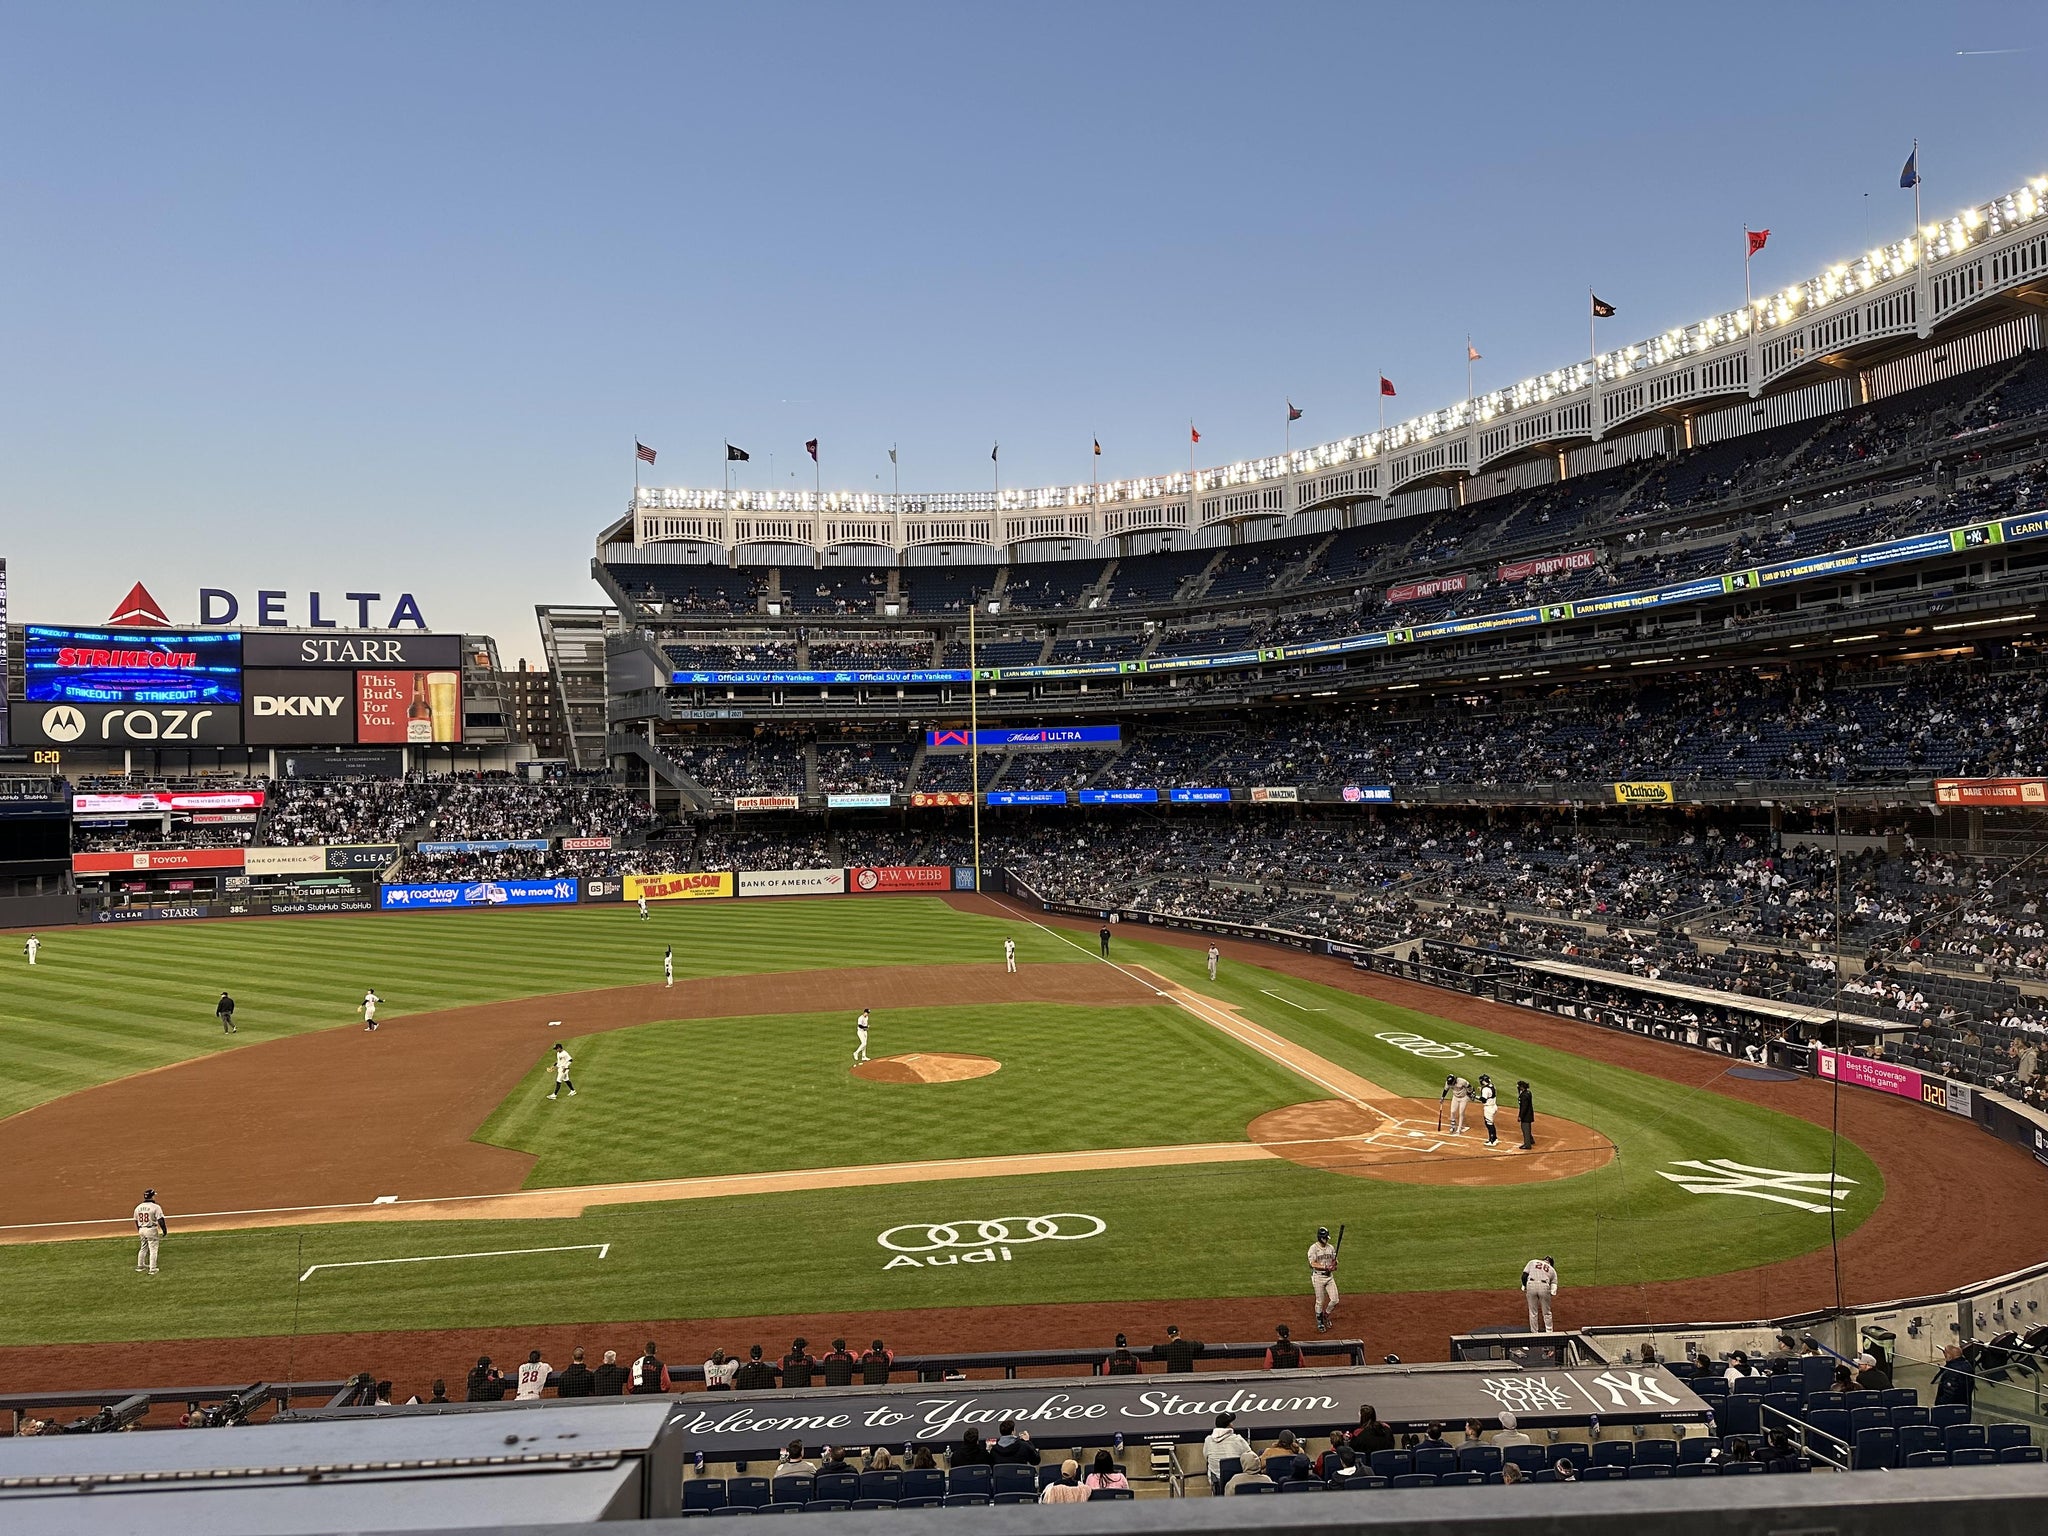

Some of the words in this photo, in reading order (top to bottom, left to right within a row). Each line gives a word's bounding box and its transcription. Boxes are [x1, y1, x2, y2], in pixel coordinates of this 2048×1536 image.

[2010, 522, 2042, 536] LEARN
[1536, 559, 1564, 574] PARTY
[1564, 554, 1590, 568] DECK
[1417, 582, 1442, 596] PARTY
[1442, 577, 1463, 592] DECK
[200, 588, 427, 629] DELTA
[1577, 605, 1594, 614] EARN
[1594, 603, 1612, 612] FOUR
[1614, 600, 1630, 609] FREE
[28, 628, 69, 638] STRIKEOUT!
[1416, 630, 1432, 638] LEARN
[302, 639, 406, 663] STARR
[56, 647, 196, 668] STRIKEOUT!
[362, 675, 396, 686] This
[718, 674, 744, 682] Official
[746, 674, 761, 682] SUV
[762, 674, 770, 682] of
[771, 674, 784, 682] the
[785, 674, 814, 682] Yankees
[859, 673, 885, 681] Official
[886, 673, 901, 681] SUV
[902, 672, 911, 680] of
[925, 672, 952, 680] Yankees
[66, 686, 122, 700] STRIKEOUT!
[135, 690, 196, 700] STRIKEOUT!
[363, 688, 403, 700] Bud's
[254, 696, 344, 716] DKNY
[363, 701, 388, 712] For
[102, 710, 212, 740] razr
[362, 714, 395, 726] You.
[1006, 733, 1040, 742] Michelob
[1048, 732, 1081, 740] ULTRA
[34, 751, 59, 764] 0:20
[1619, 784, 1667, 799] Nathan's
[1962, 788, 1982, 796] DARE
[1983, 788, 1991, 796] TO
[1992, 788, 2017, 796] LISTEN
[2025, 787, 2040, 796] JBL
[737, 799, 757, 807] Parts
[759, 797, 795, 807] Authority
[223, 814, 255, 822] TERRACE
[564, 839, 610, 848] Reebok
[152, 856, 188, 864] TOYOTA
[354, 854, 392, 863] CLEAR
[880, 870, 901, 881] F.W.
[904, 870, 942, 880] WEBB
[410, 888, 459, 901] roadway
[511, 888, 527, 896] We
[161, 907, 199, 918] STARR
[272, 905, 305, 913] StubHub
[341, 902, 372, 910] StubHub
[1846, 1060, 1862, 1071] Best
[1863, 1065, 1873, 1073] 5G
[1874, 1069, 1906, 1082] coverage
[1864, 1074, 1876, 1084] the
[1877, 1078, 1898, 1088] game
[882, 1246, 1012, 1270] Audi
[1535, 1261, 1550, 1273] 26
[522, 1370, 539, 1384] 28
[1481, 1376, 1548, 1391] NEW
[1480, 1386, 1572, 1400] YORK
[1500, 1398, 1572, 1412] LIFE
[864, 1406, 914, 1427] to
[916, 1394, 1108, 1439] Yankee
[1120, 1389, 1340, 1418] Stadium
